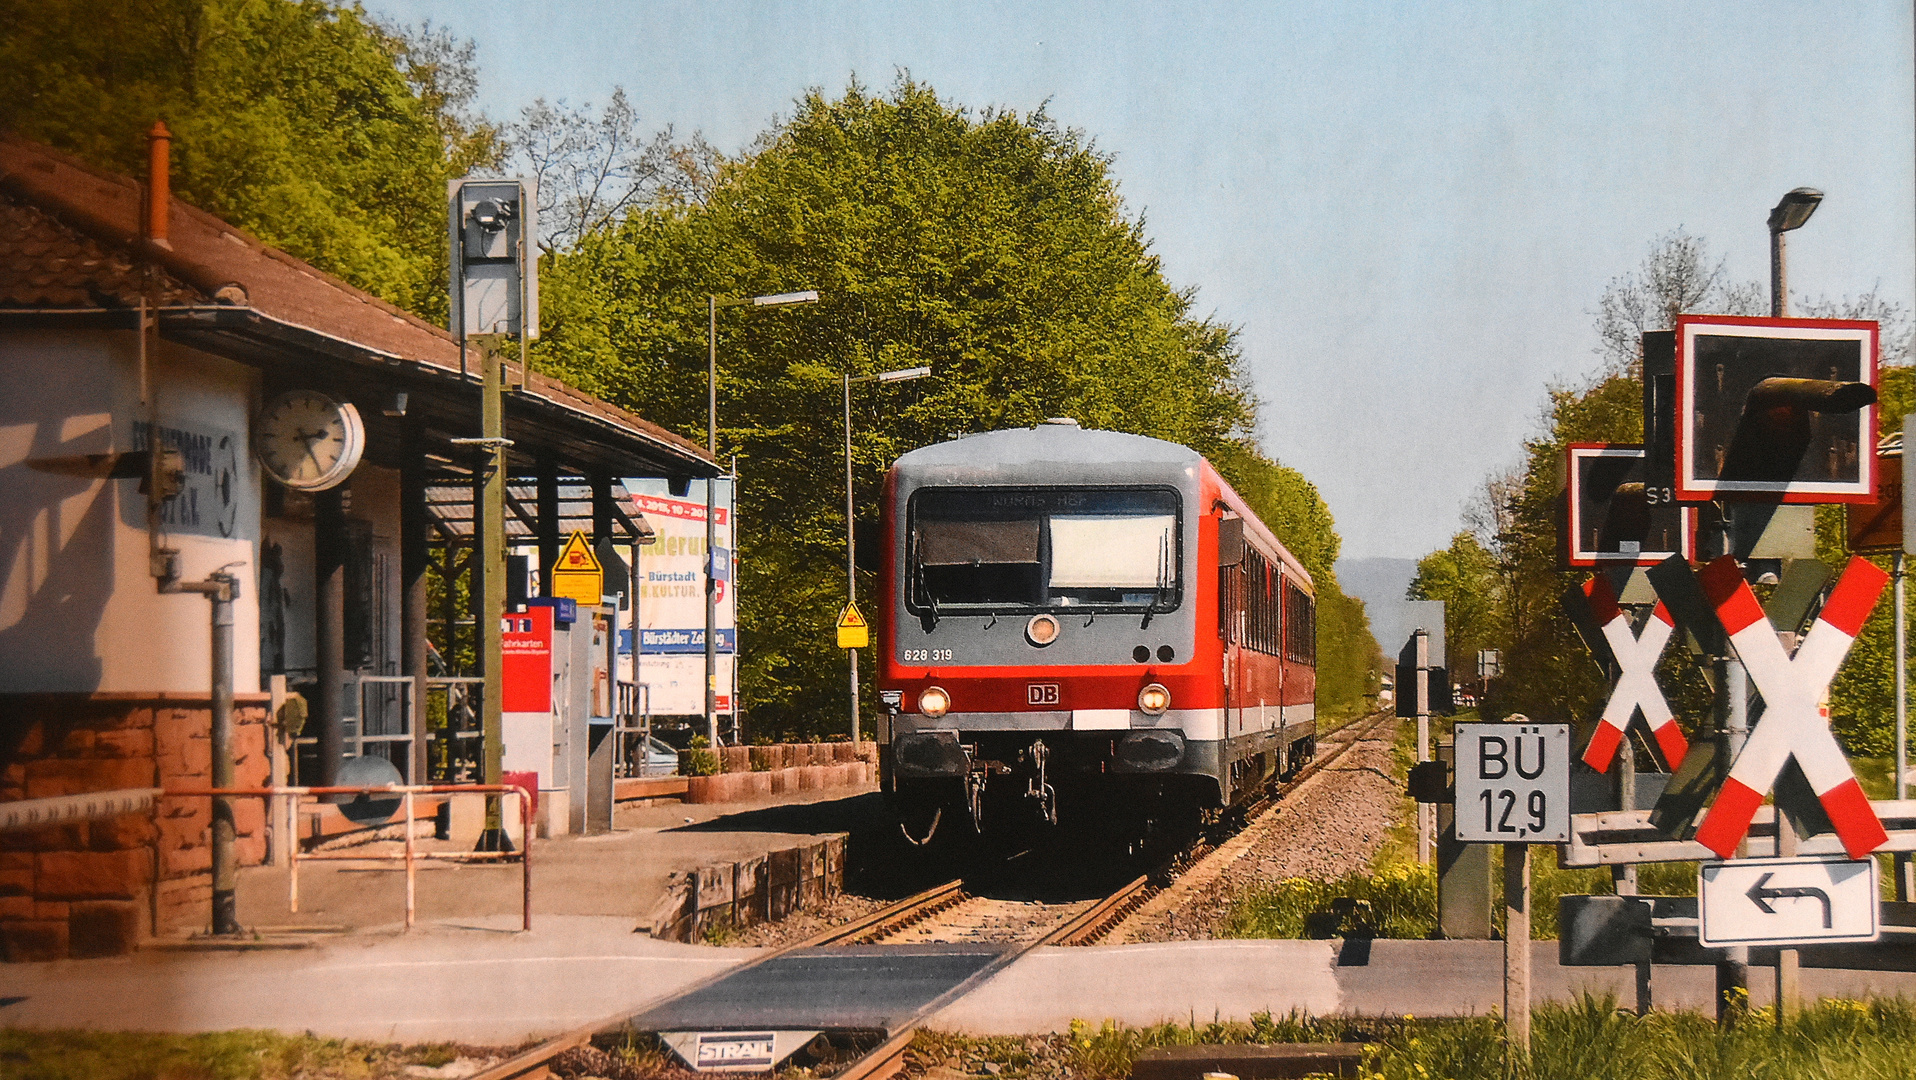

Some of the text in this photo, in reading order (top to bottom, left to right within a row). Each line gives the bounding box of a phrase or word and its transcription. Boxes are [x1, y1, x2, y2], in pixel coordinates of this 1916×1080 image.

[648, 571, 697, 582] Bürstadt
[643, 631, 689, 646] Bürstädter
[904, 650, 953, 662] 628 319
[1029, 685, 1059, 704] DB
[1479, 726, 1545, 780] BÜ
[1480, 789, 1546, 838] 12,9
[699, 1041, 774, 1061] STRAIL
